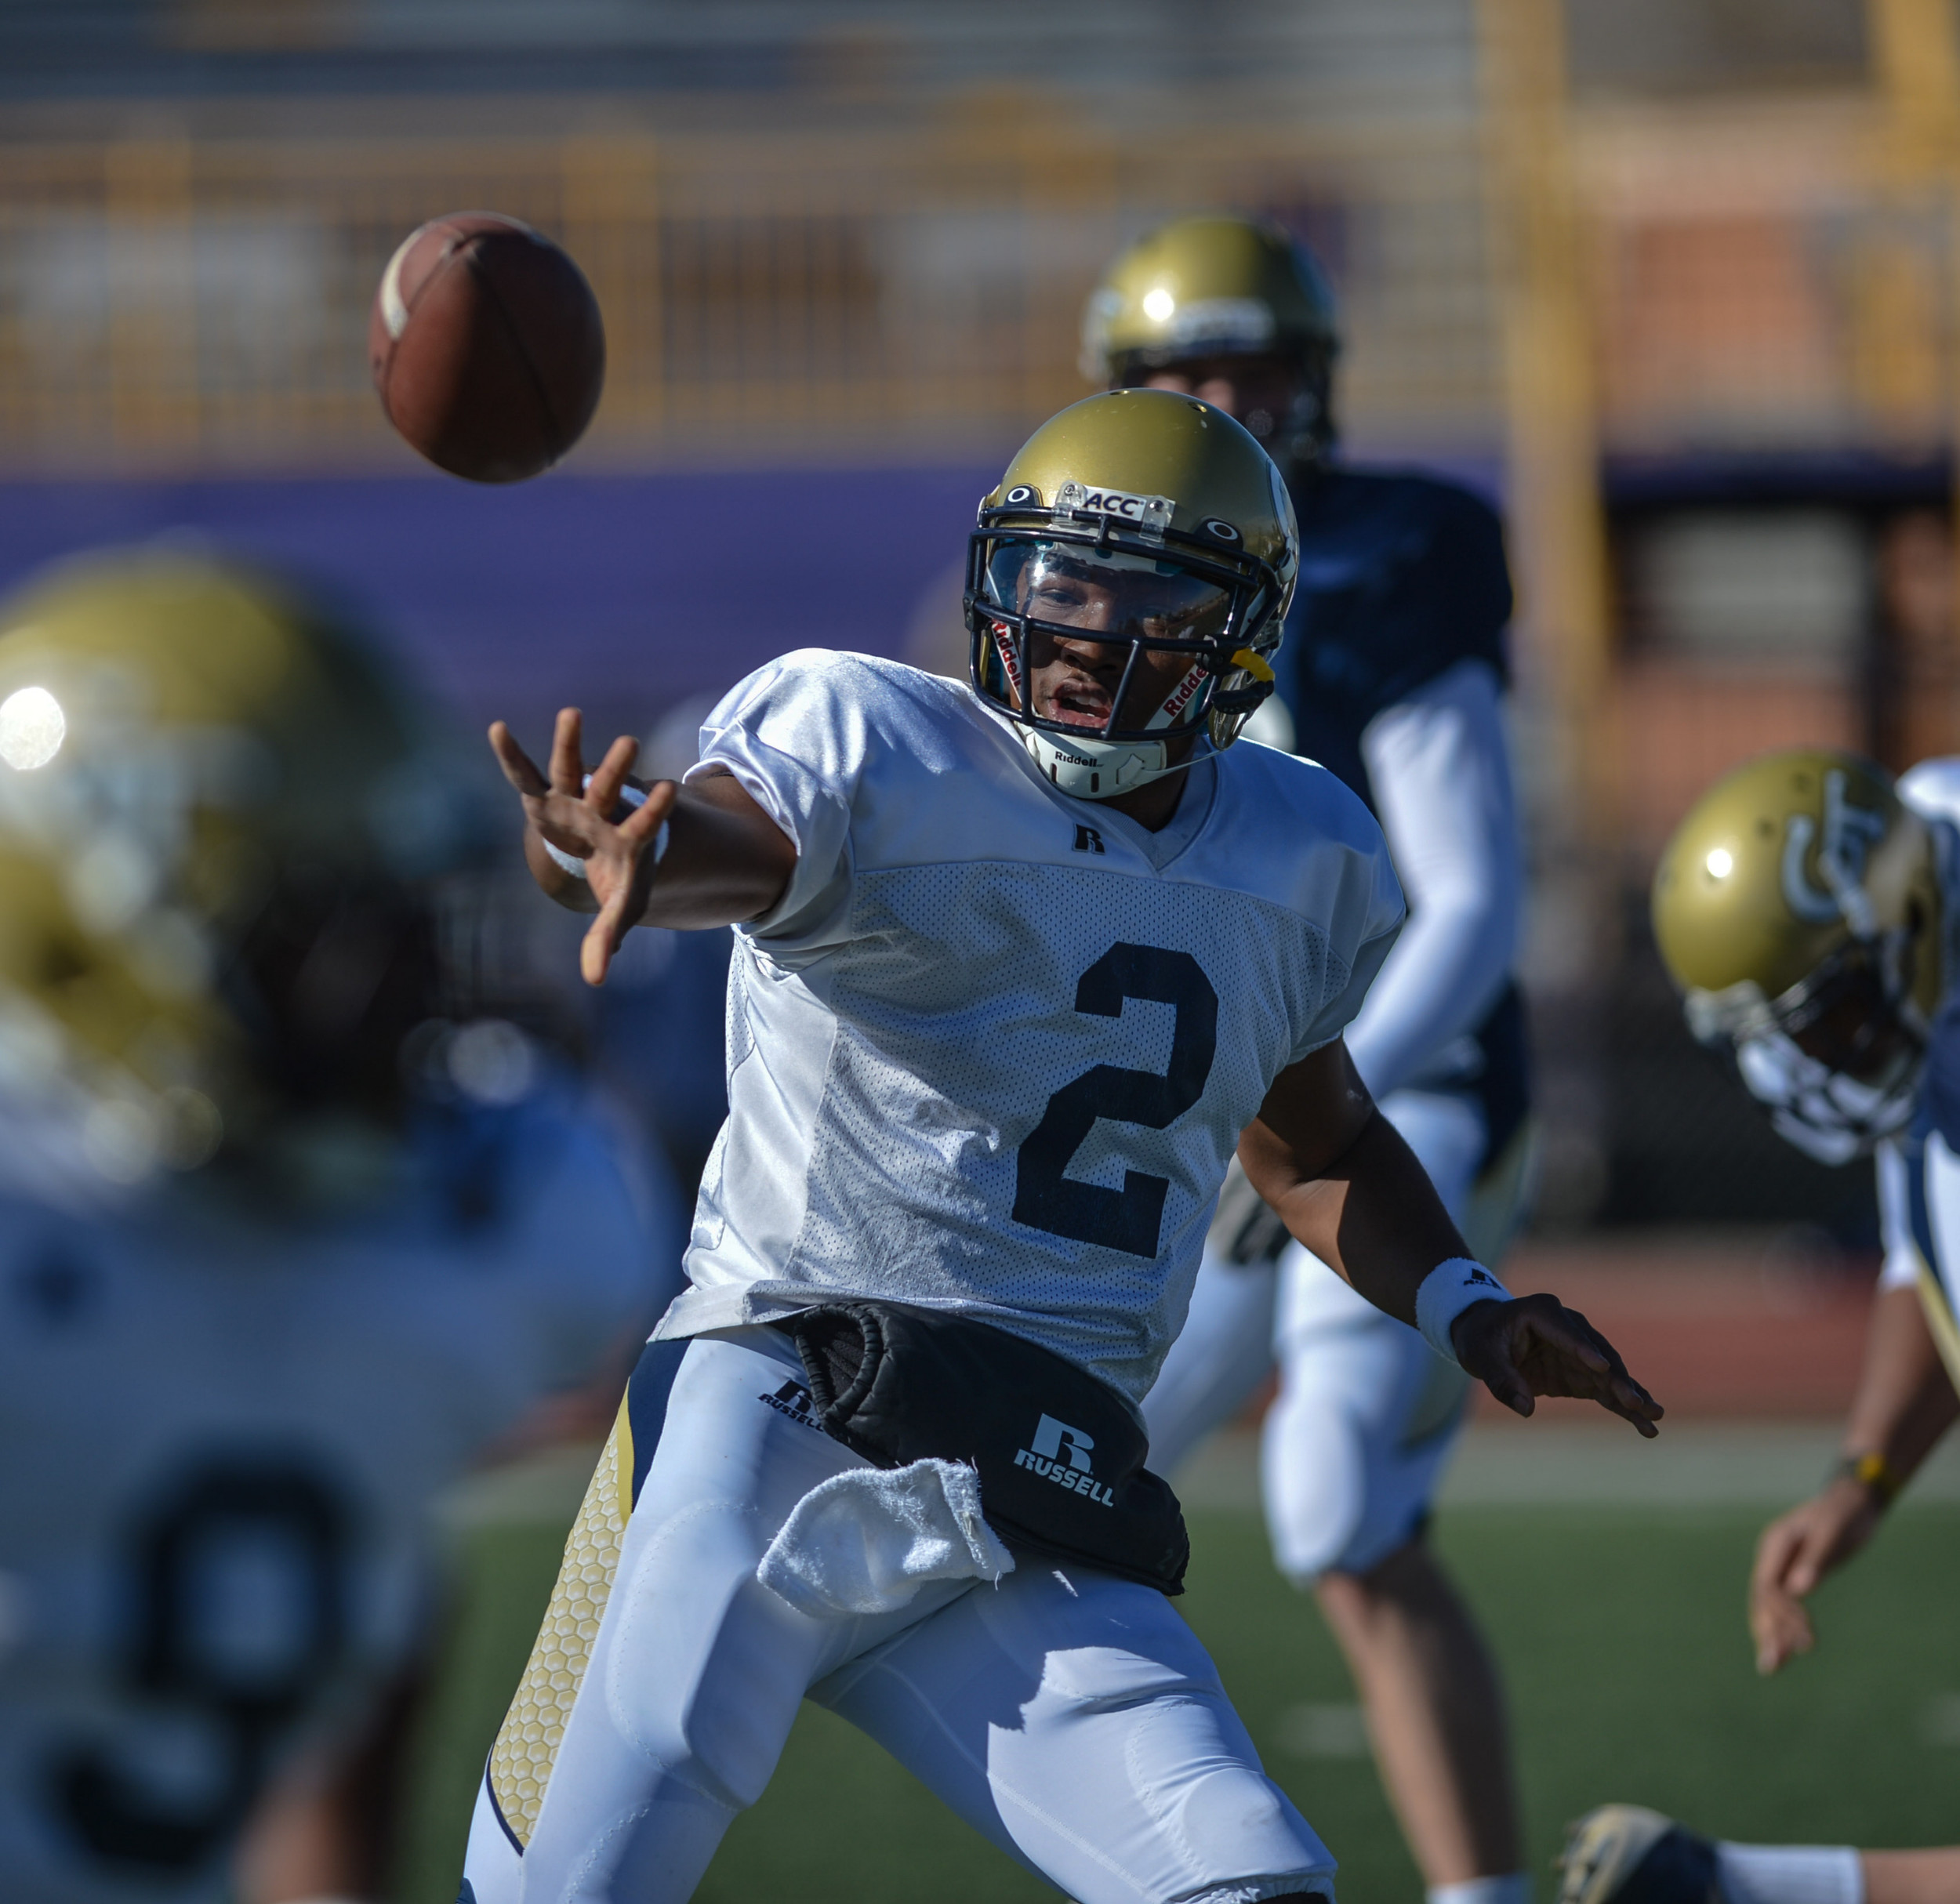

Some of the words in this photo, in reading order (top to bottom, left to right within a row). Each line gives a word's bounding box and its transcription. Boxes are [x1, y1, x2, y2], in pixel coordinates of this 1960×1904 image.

[1083, 493, 1140, 517] ACC
[1163, 666, 1208, 717] Ridde
[1054, 751, 1098, 767] Riddell
[1073, 823, 1106, 854] R
[1011, 941, 1218, 1260] 2
[1031, 1413, 1094, 1474] R
[1013, 1449, 1114, 1507] RUSSELL
[59, 1434, 361, 1881] 9
